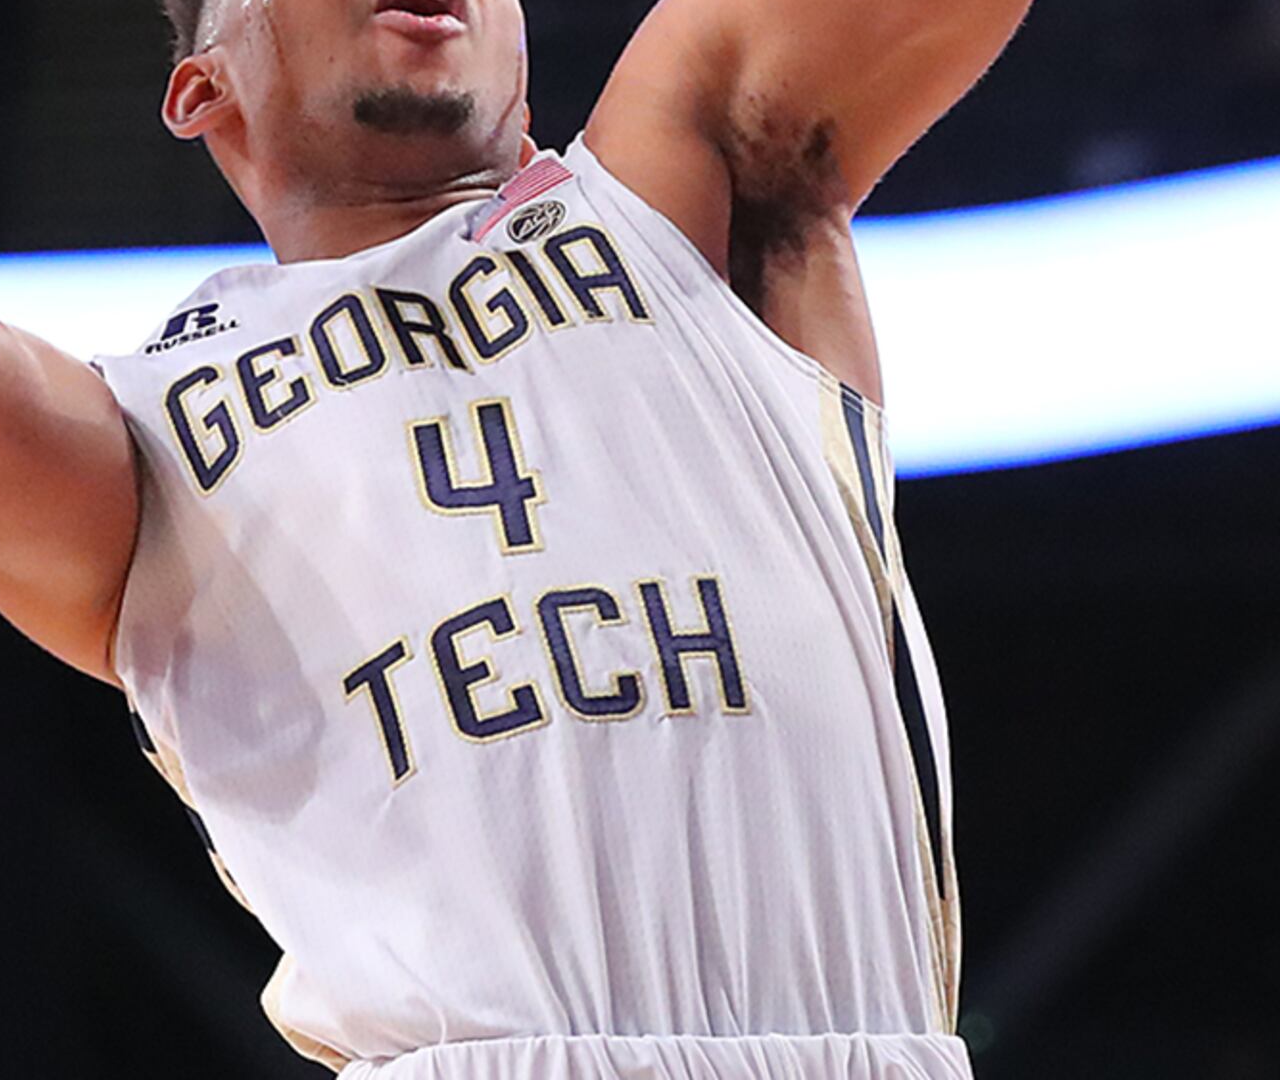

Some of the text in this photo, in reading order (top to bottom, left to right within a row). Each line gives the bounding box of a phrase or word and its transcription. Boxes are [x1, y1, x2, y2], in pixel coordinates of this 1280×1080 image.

[145, 320, 240, 354] RUSSELL
[164, 224, 654, 497] GEORGIA
[406, 397, 547, 556] 4
[342, 574, 751, 788] TECH
